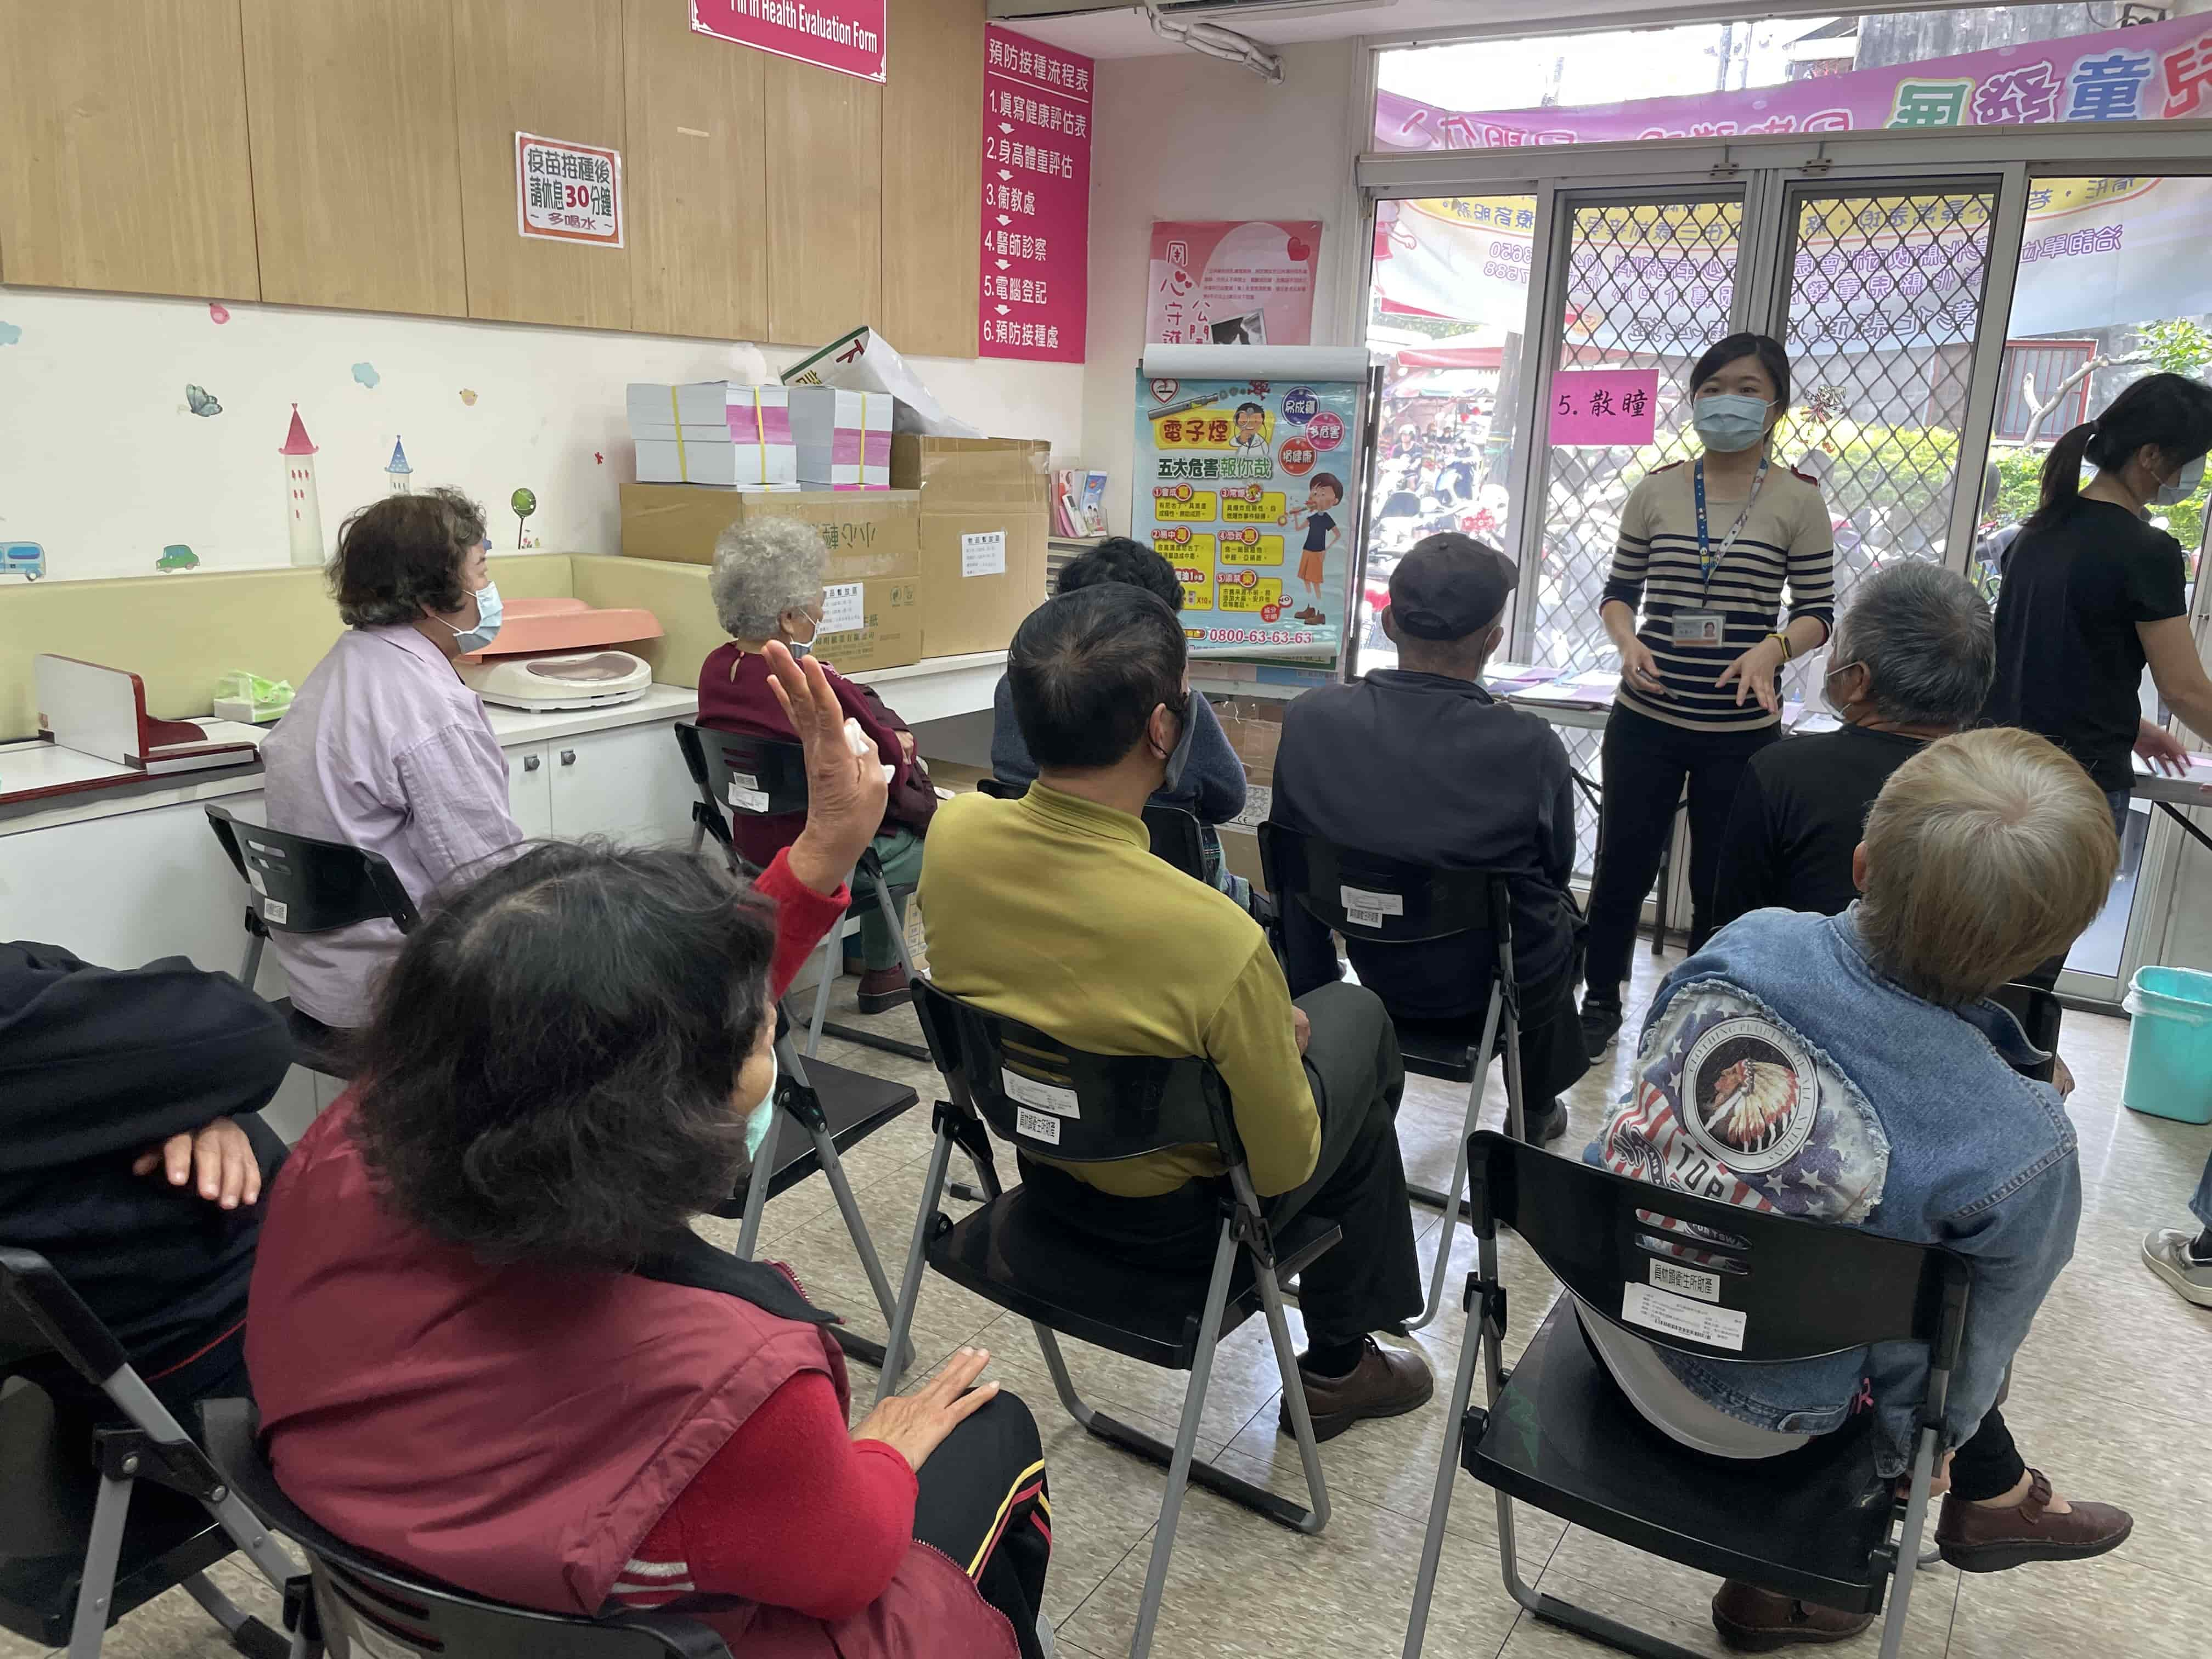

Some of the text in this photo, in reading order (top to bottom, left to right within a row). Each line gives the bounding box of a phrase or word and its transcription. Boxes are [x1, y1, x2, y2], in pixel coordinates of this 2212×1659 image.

[799, 4, 850, 46] Evaluation
[853, 21, 877, 53] Form
[989, 38, 1089, 93] 預防接種流程表
[527, 148, 611, 185] 疫苗接種後
[986, 137, 1073, 179] 2.身高體重評估
[529, 176, 612, 217] 請休息30分鐘
[548, 212, 596, 230] 多喝水
[984, 230, 1047, 261] 4.醫師診察
[984, 275, 1047, 304] 5.電腦登記
[983, 320, 1058, 348] 6.預防接種處
[1558, 388, 1649, 417] 5. 散瞳
[1163, 419, 1228, 442] 電子煙
[1209, 629, 1312, 644] 0800-63-63-63
[1689, 1025, 1737, 1073] CLOTHING
[1675, 1142, 1725, 1198] TOP
